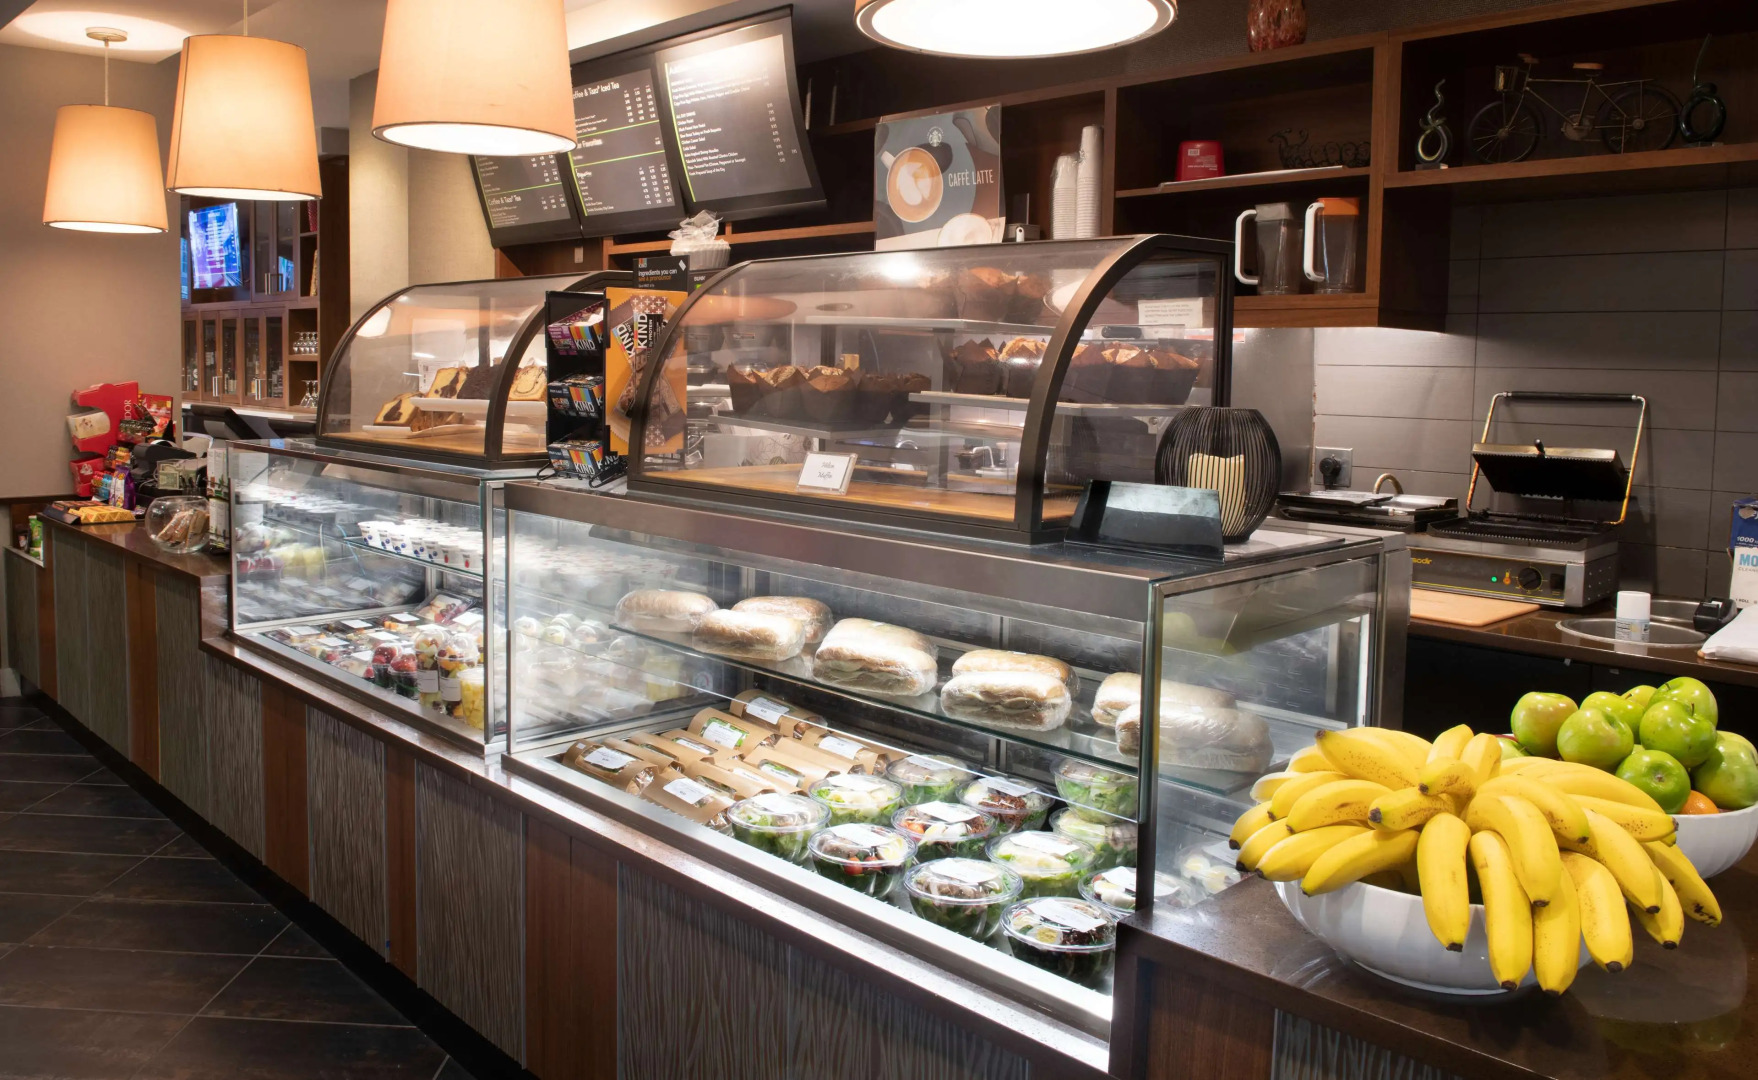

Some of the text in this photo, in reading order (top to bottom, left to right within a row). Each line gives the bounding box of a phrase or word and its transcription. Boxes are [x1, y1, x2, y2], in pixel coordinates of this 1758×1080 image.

[601, 83, 610, 92] Iced
[948, 169, 994, 187] CAFFÈ LATTE
[638, 313, 648, 348] KIND
[575, 339, 596, 350] KIND
[617, 323, 635, 358] KIND
[573, 400, 595, 412] KIND
[574, 463, 595, 475] KIND
